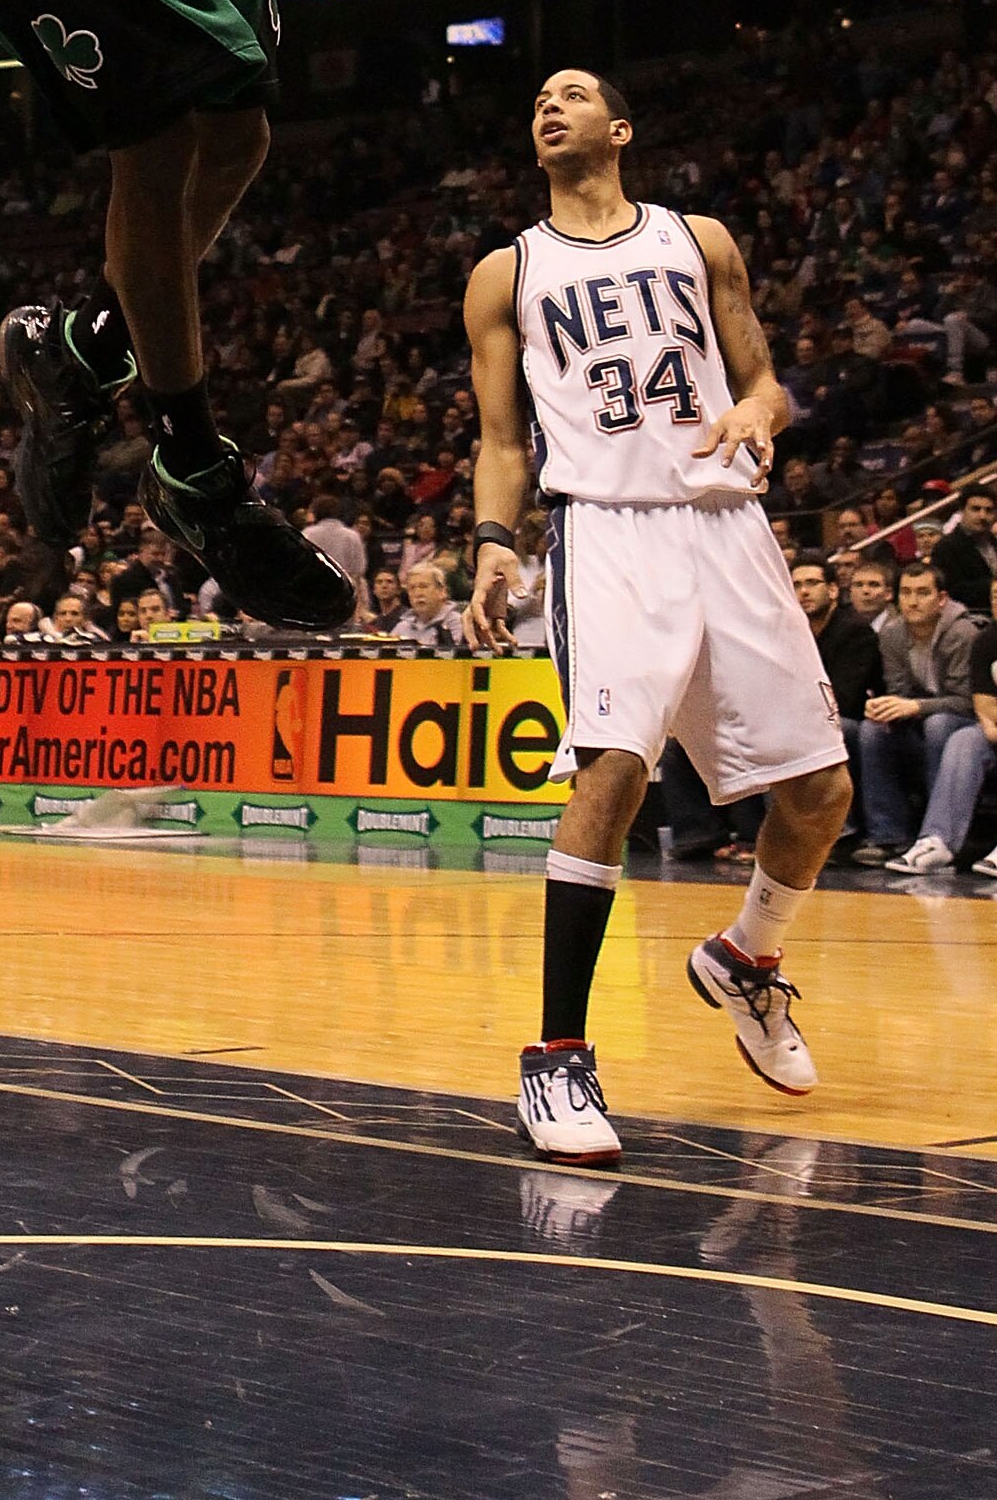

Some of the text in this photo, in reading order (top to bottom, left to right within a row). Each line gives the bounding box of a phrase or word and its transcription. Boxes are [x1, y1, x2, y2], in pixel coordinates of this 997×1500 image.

[539, 266, 707, 380] NETS
[585, 345, 702, 435] 34
[57, 668, 97, 717] OF
[105, 668, 164, 717] THE
[173, 668, 241, 718] NBA
[317, 666, 577, 792] Haie
